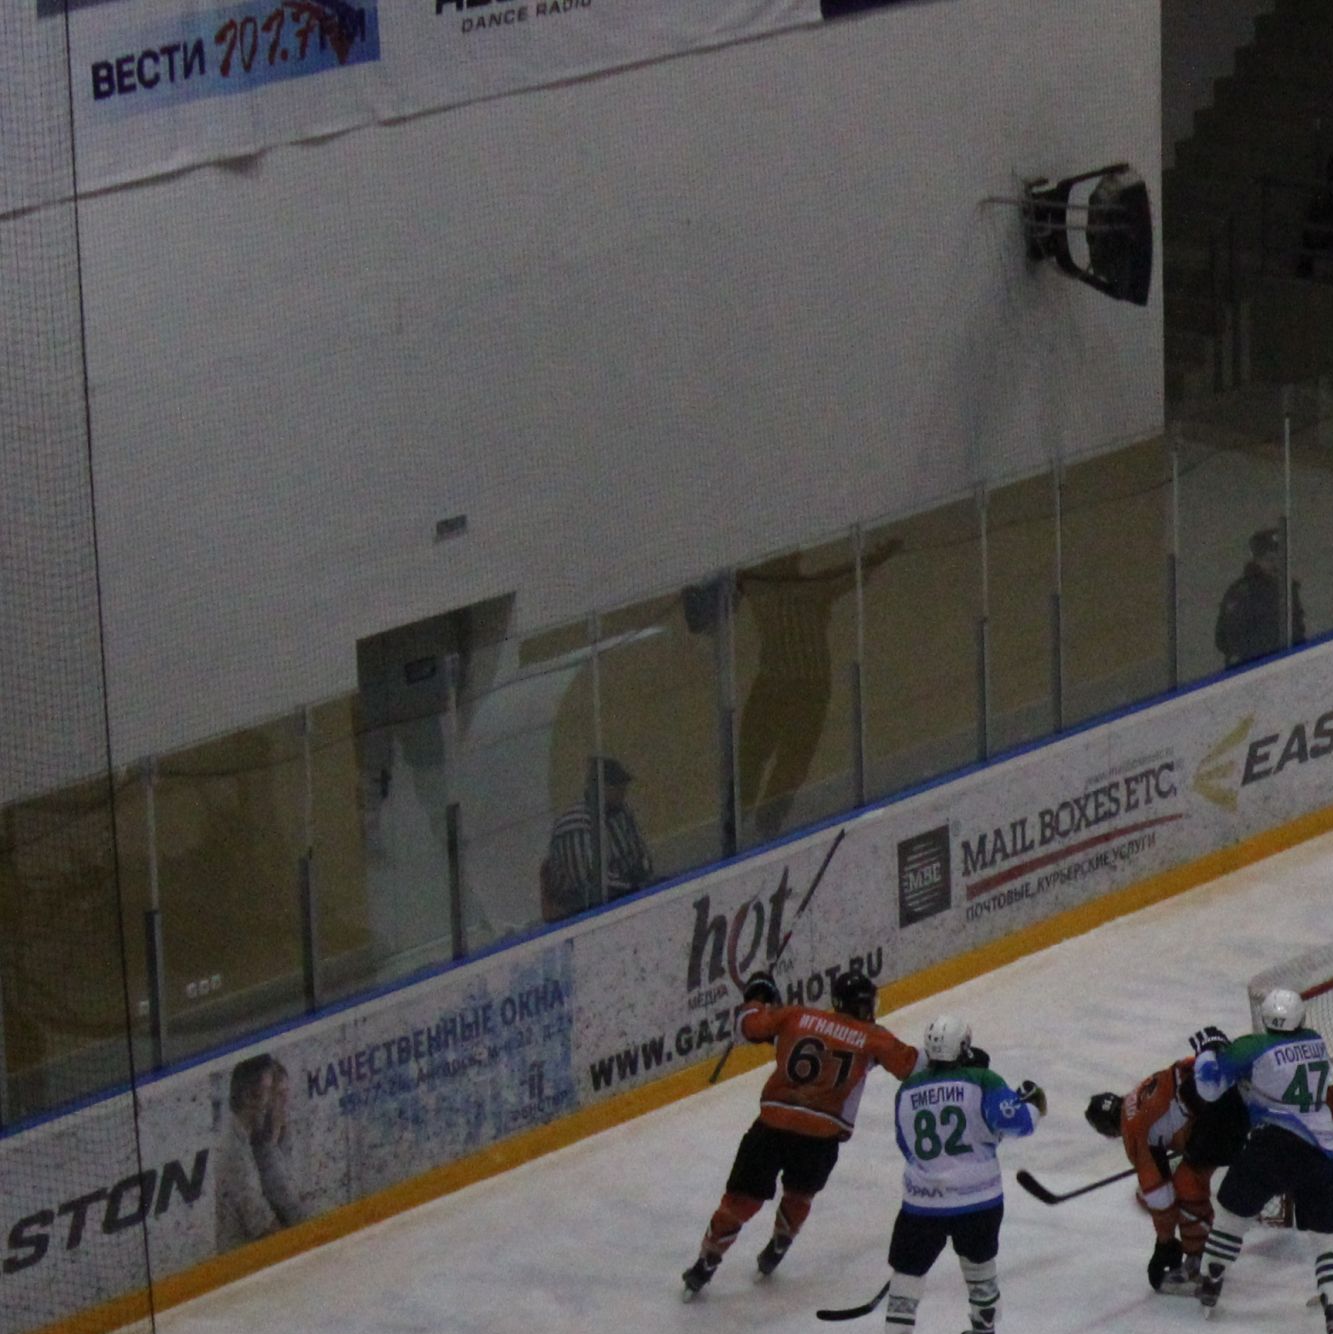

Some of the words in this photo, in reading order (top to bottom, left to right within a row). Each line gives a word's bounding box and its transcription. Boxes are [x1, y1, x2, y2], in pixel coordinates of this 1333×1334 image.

[461, 6, 528, 33] DANCE
[536, 0, 592, 17] RADIO
[91, 38, 205, 100] ВЕСТИ
[961, 816, 1035, 877] MAIL
[1039, 781, 1121, 847] BOXES
[687, 866, 792, 994] hot
[307, 1001, 494, 1100] КАЧЕСТВЕННЫЕ
[502, 977, 566, 1026] ОКНА
[910, 1087, 965, 1111] ЕМЕЛИН
[1282, 1061, 1330, 1113] 47
[914, 1105, 975, 1161] 82
[3, 1148, 208, 1275] STON
